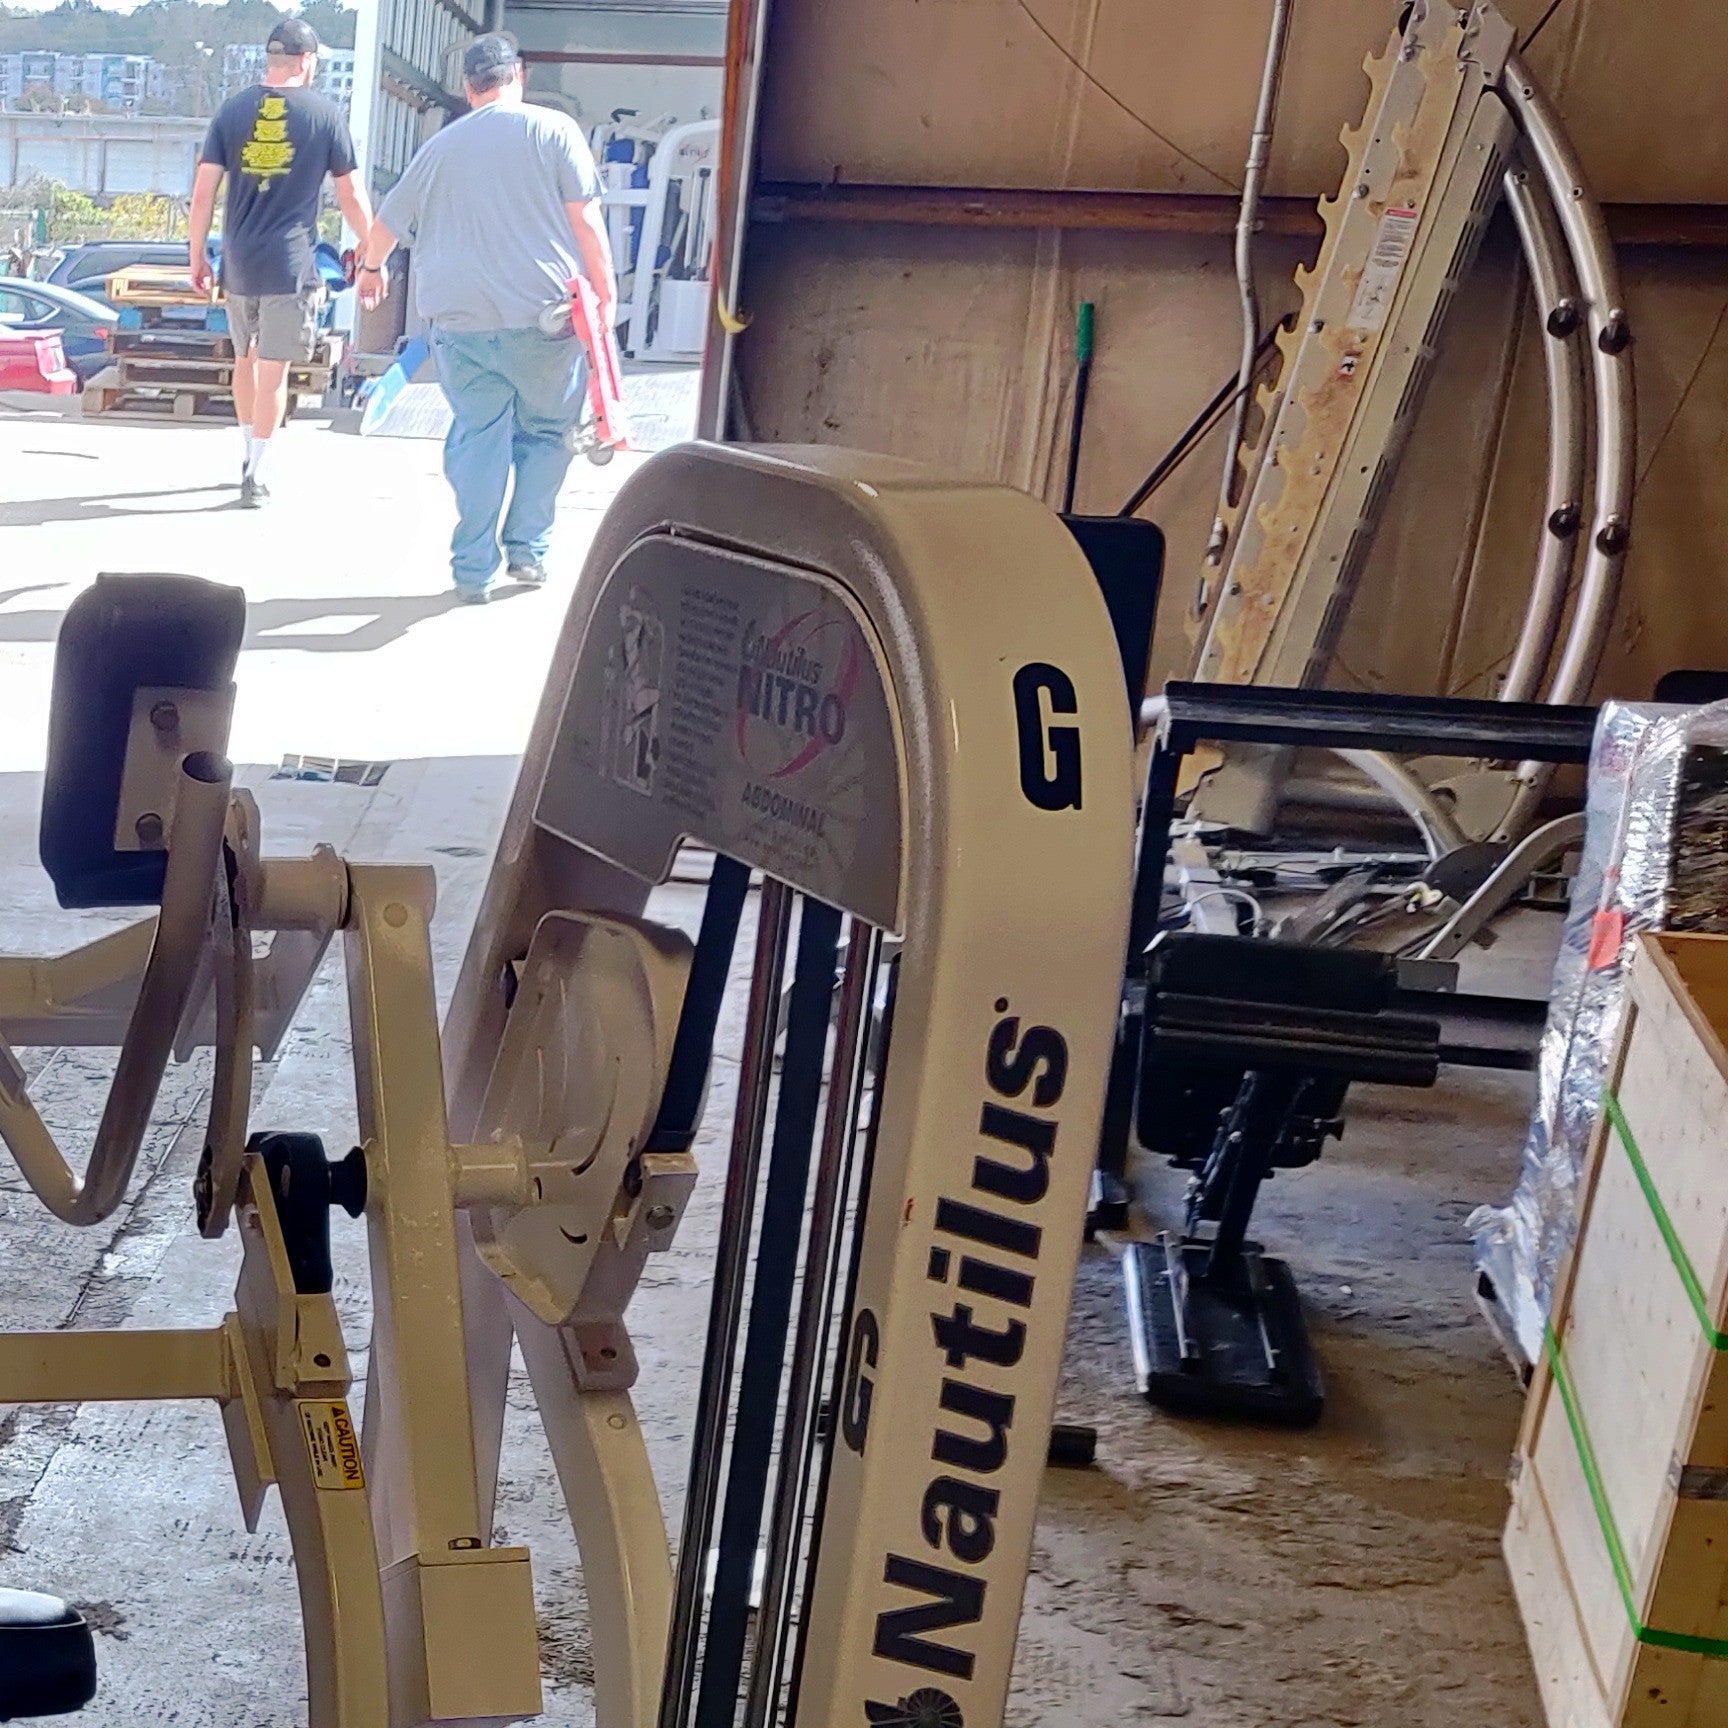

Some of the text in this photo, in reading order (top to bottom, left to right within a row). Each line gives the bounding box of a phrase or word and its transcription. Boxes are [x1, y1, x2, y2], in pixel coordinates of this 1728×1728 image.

[737, 663, 846, 746] NITRO
[1012, 662, 1084, 813] G
[741, 781, 825, 837] ABDOMINAL
[873, 1013, 1069, 1682] Nautilus
[334, 1417, 360, 1481] CAUTION
